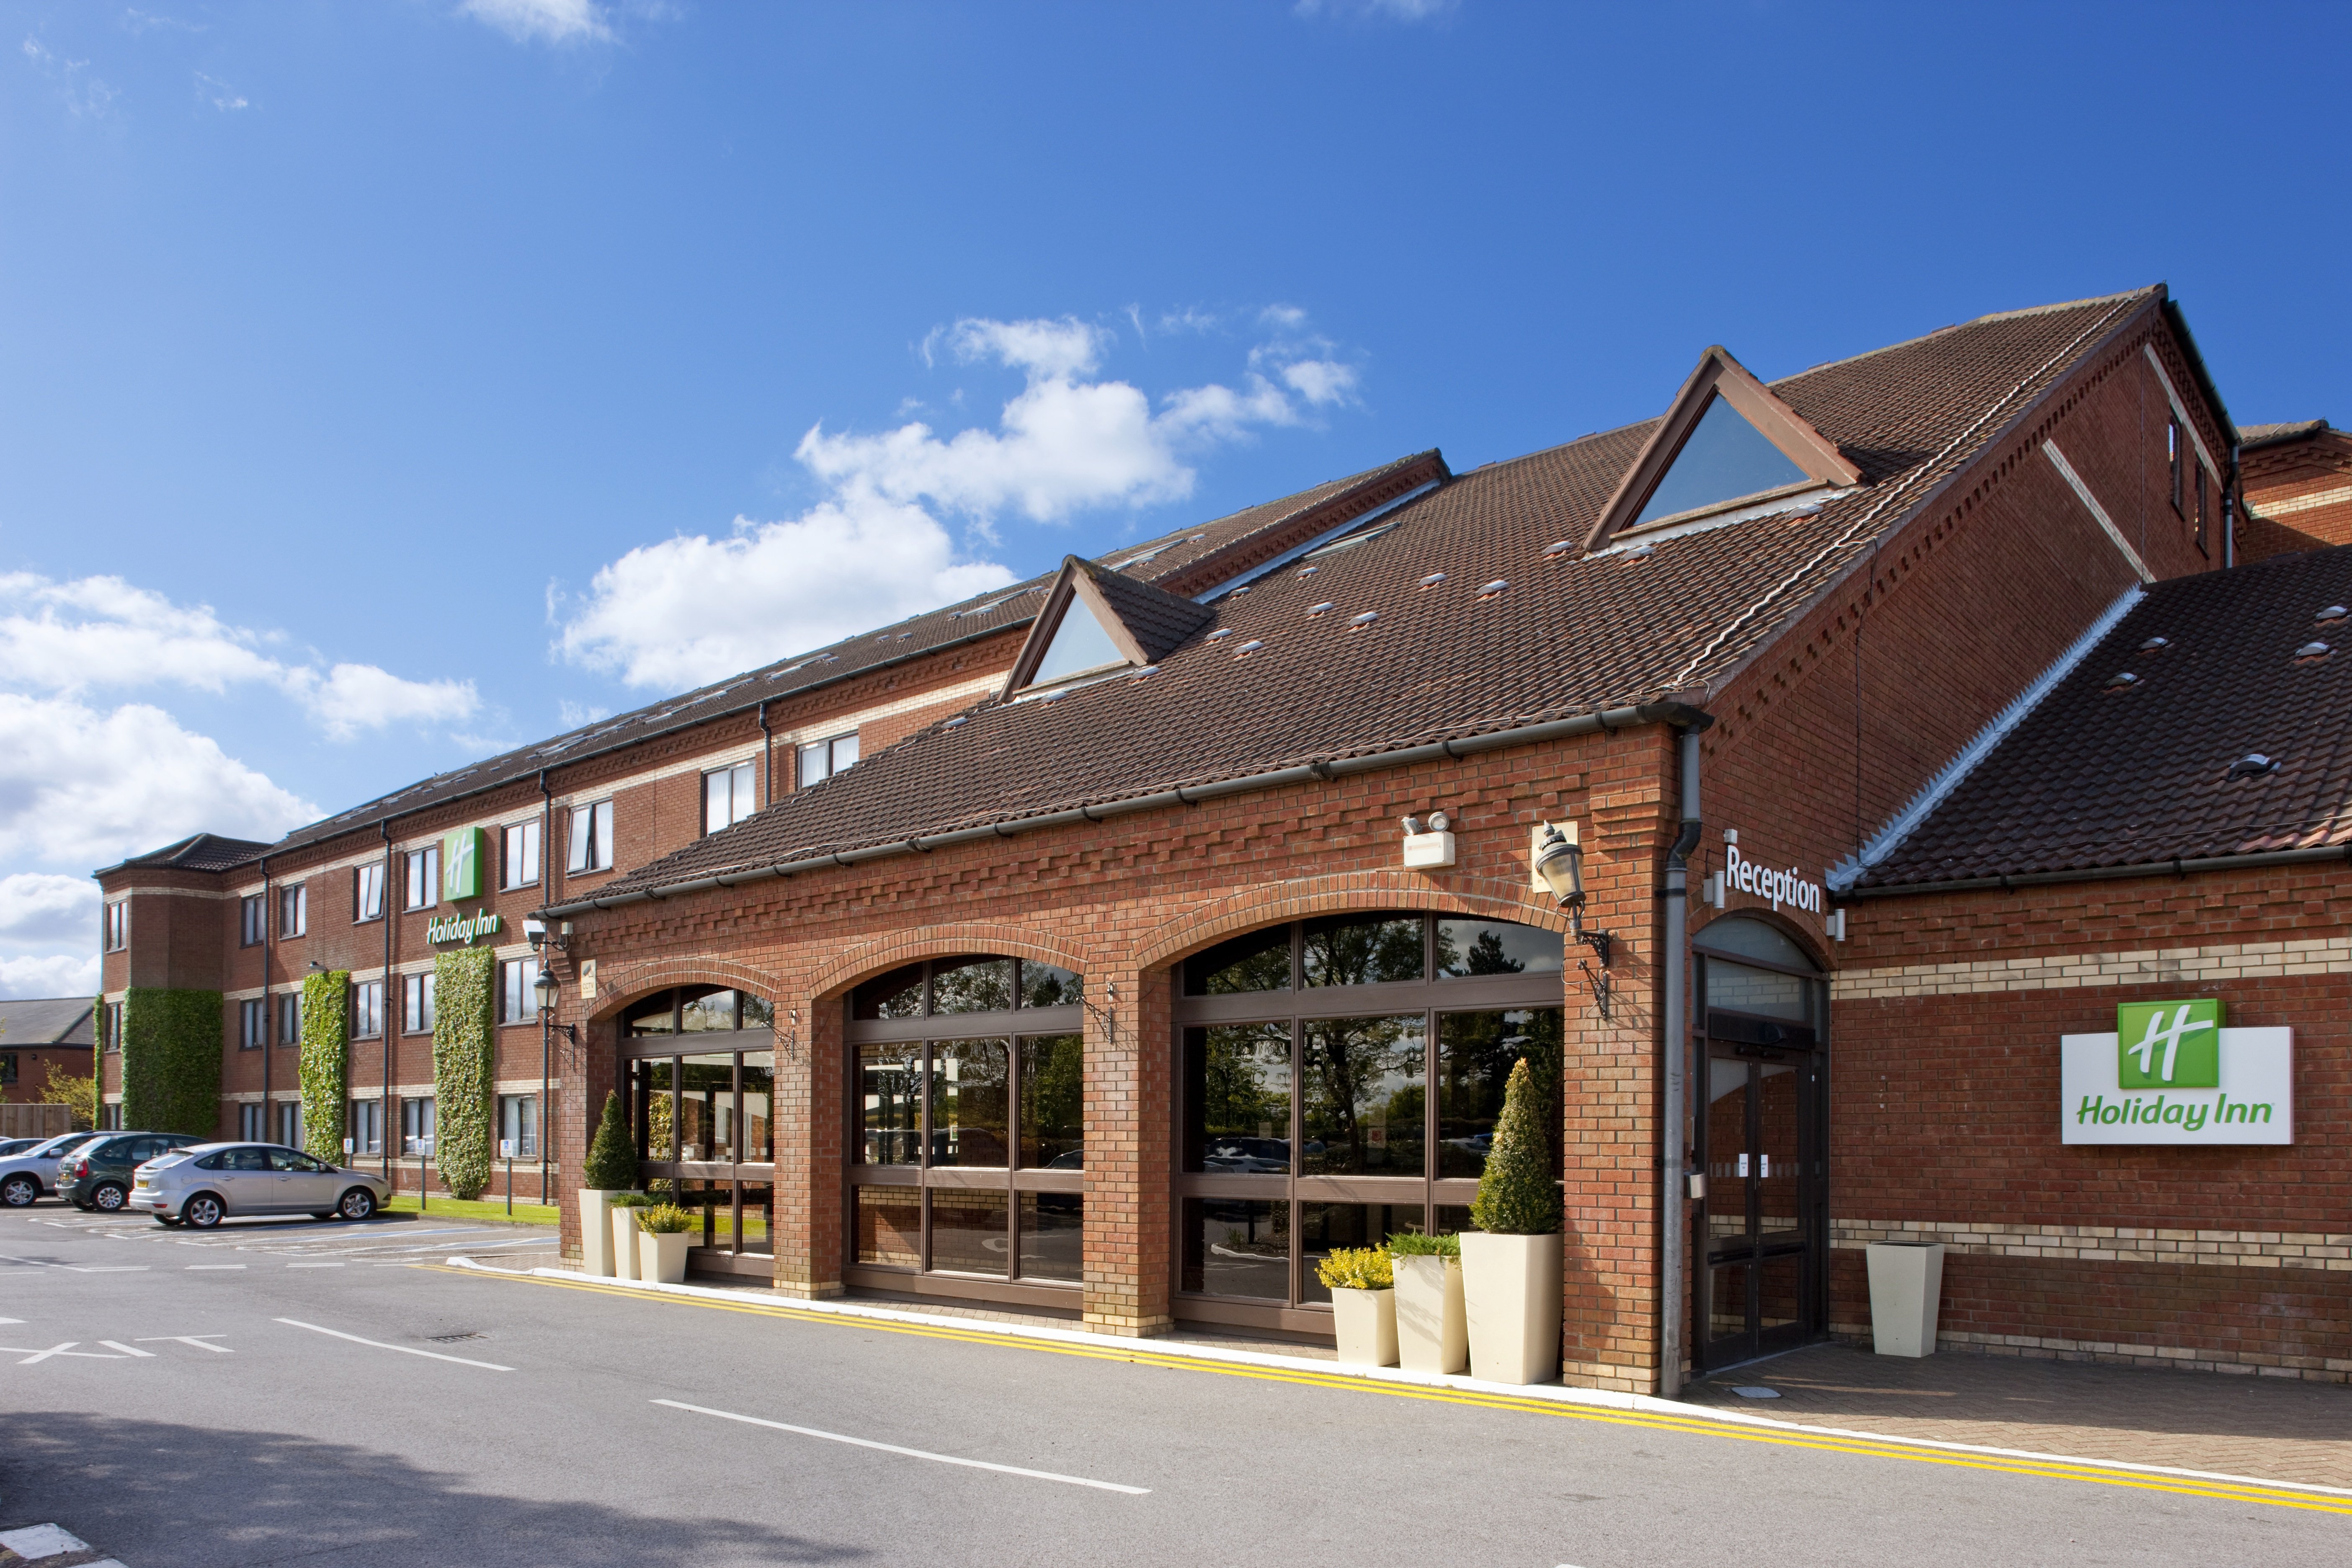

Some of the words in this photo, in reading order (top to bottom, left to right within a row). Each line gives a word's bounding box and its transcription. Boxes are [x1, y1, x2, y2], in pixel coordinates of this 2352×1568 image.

[1726, 845, 1820, 913] Reception
[426, 913, 476, 944] Holiday
[475, 908, 498, 936] Inn
[2076, 1095, 2209, 1132] Holiday
[2214, 1093, 2273, 1124] Inn
